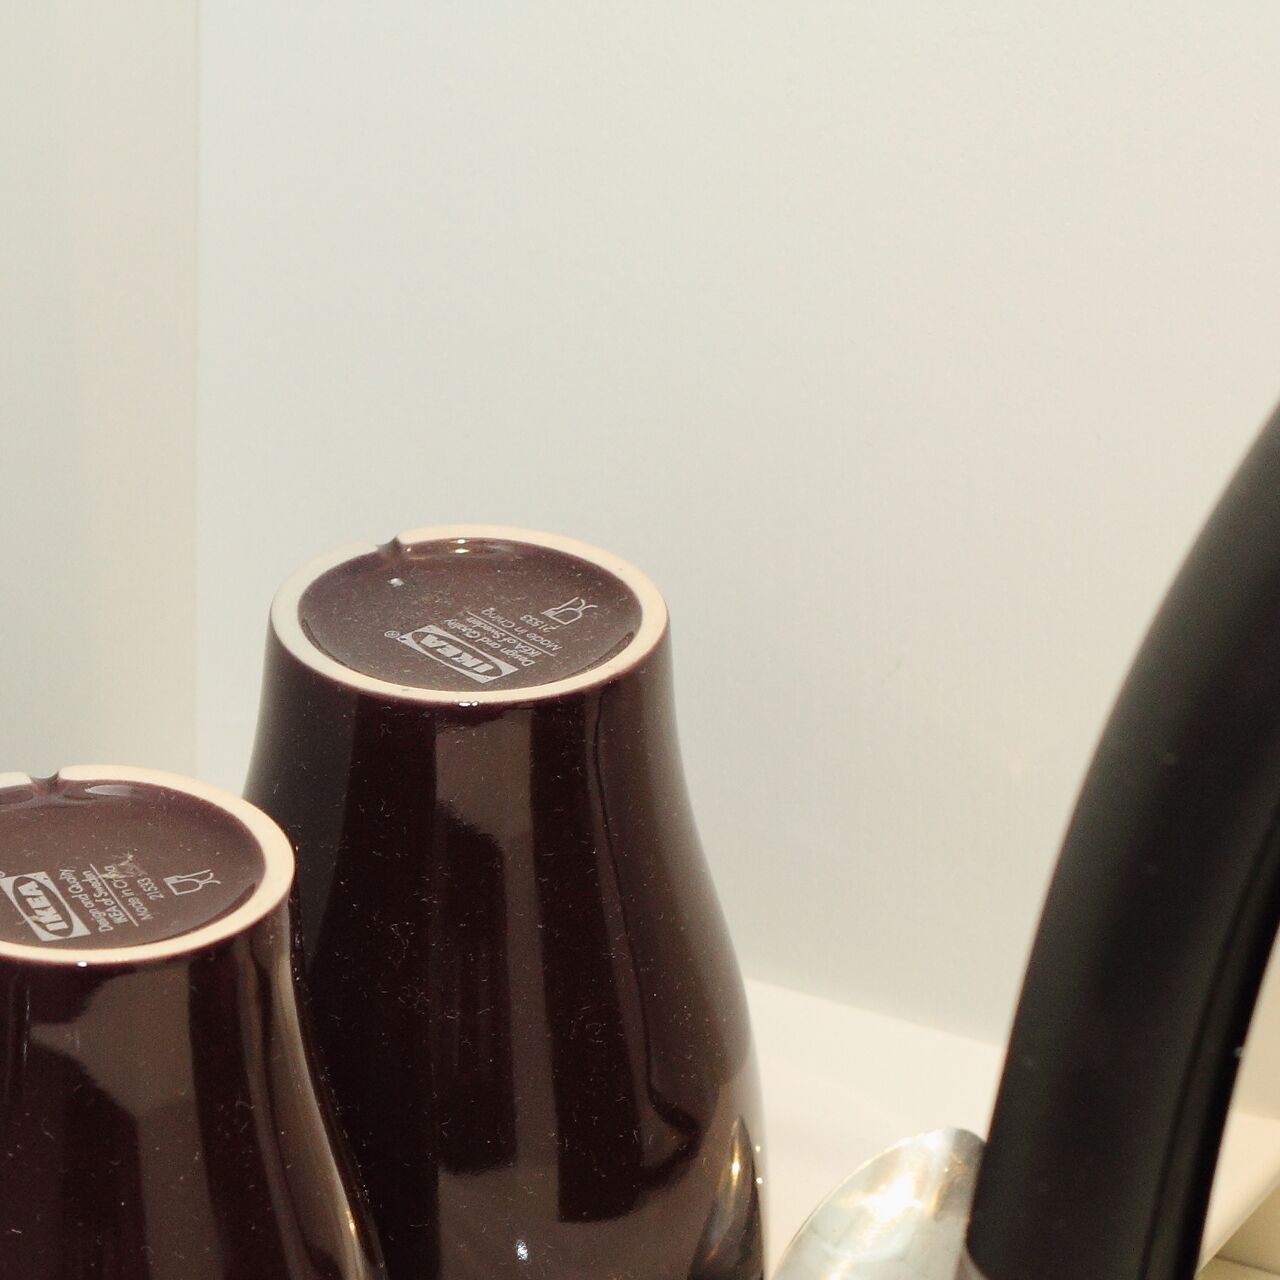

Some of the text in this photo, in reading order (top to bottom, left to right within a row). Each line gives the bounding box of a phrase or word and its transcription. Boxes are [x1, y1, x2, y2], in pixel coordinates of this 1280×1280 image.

[444, 618, 536, 667] Design and Quality
[466, 617, 542, 657] IKEA of Sweden
[481, 607, 563, 651] Made in China
[420, 633, 495, 674] IKEA
[17, 881, 69, 931] IKEA
[59, 869, 114, 932] Design and Quality
[82, 870, 129, 924] IKEA of Sweden
[121, 889, 135, 898] in
[128, 897, 154, 920] Made
